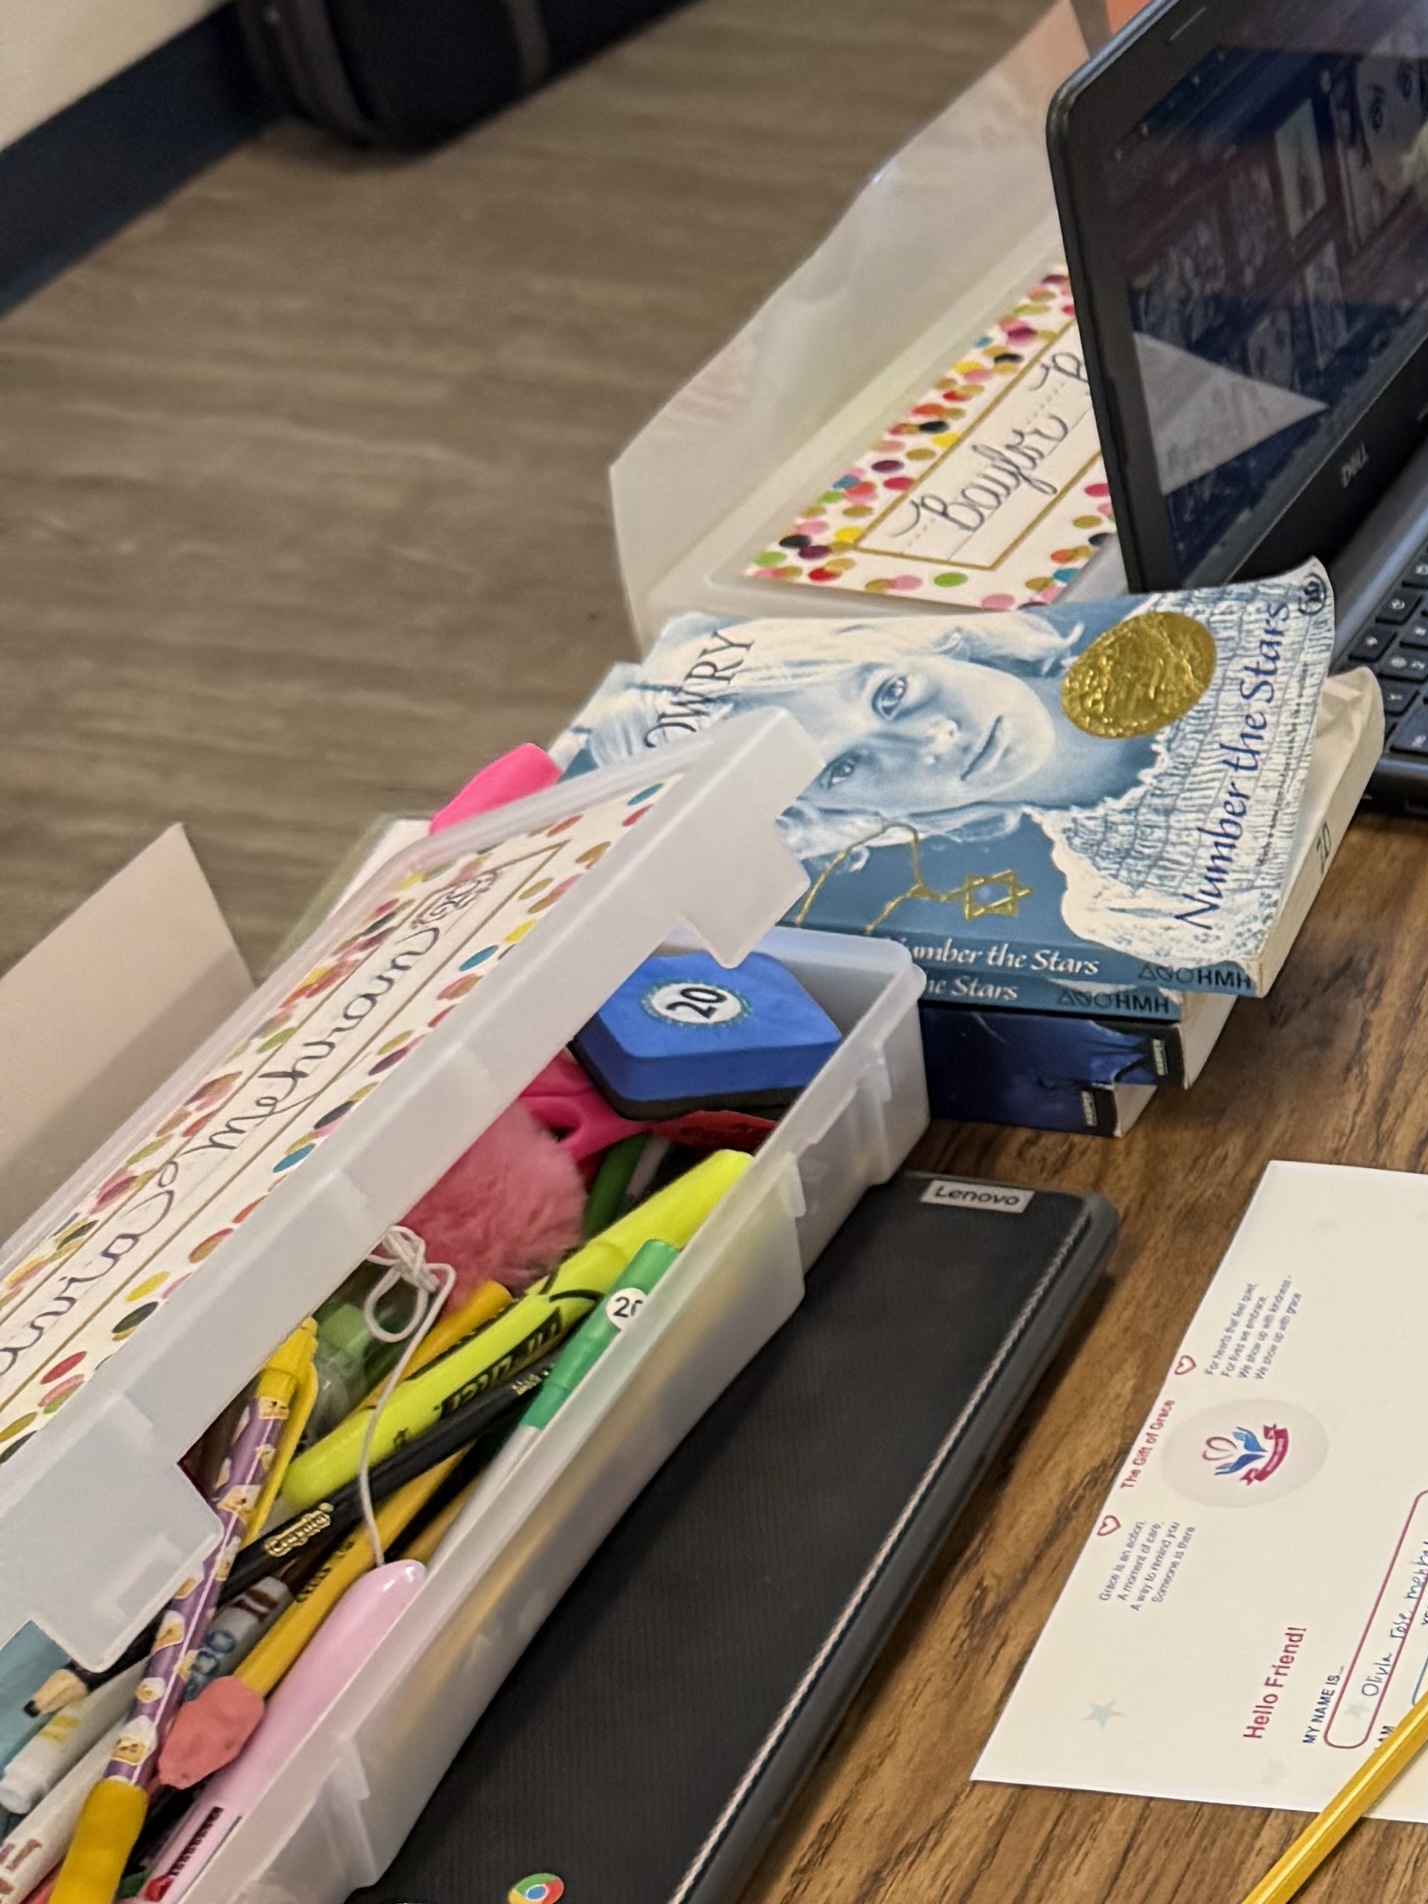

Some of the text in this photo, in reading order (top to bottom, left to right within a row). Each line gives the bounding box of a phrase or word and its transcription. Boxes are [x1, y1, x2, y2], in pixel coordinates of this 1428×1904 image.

[1172, 597, 1292, 934] Number the Stars
[908, 942, 1100, 978] umber the Stars
[1196, 968, 1251, 991] HMH
[665, 985, 729, 1027] 20
[950, 977, 1019, 1003] Stars
[1114, 994, 1169, 1016] HMH
[933, 1183, 1022, 1209] Lenovo
[1118, 1398, 1177, 1490] The Gift of Grace
[1241, 1625, 1308, 1740] Hello Friend!
[1300, 1665, 1346, 1745] MY NAME IS...
